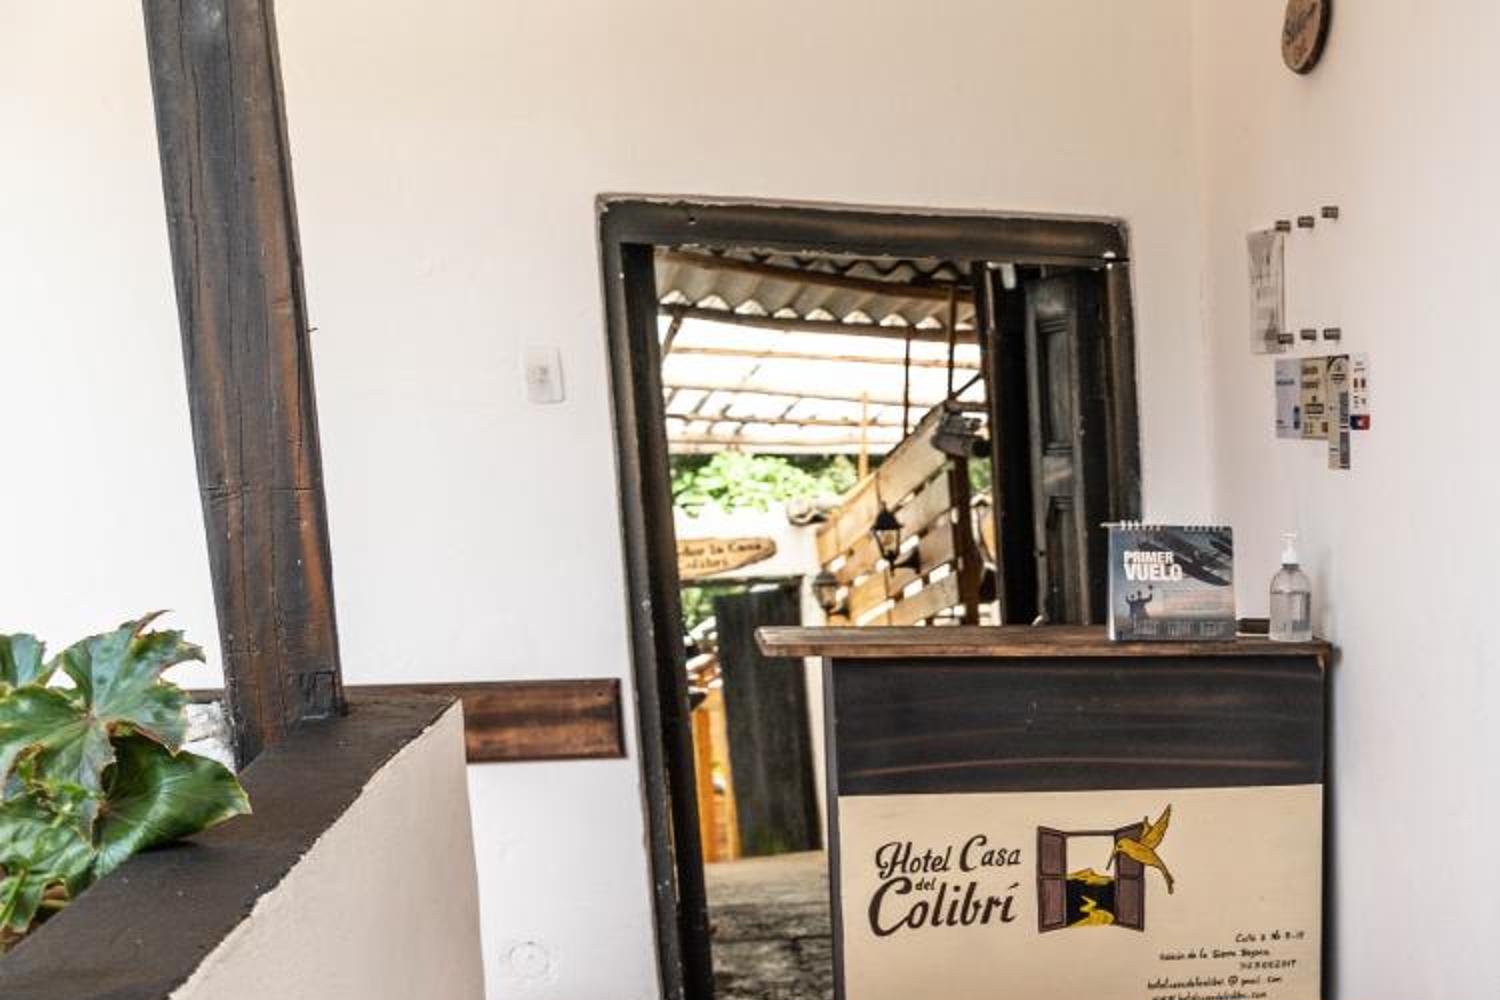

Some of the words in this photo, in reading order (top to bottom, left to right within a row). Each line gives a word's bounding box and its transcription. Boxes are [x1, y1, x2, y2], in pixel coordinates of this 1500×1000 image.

[1124, 551, 1174, 564] PRIMER
[1124, 564, 1183, 581] VUELO
[875, 841, 953, 880] Hotel
[959, 834, 1021, 872] Casa
[915, 877, 937, 891] del
[868, 876, 1020, 937] Colibrí
